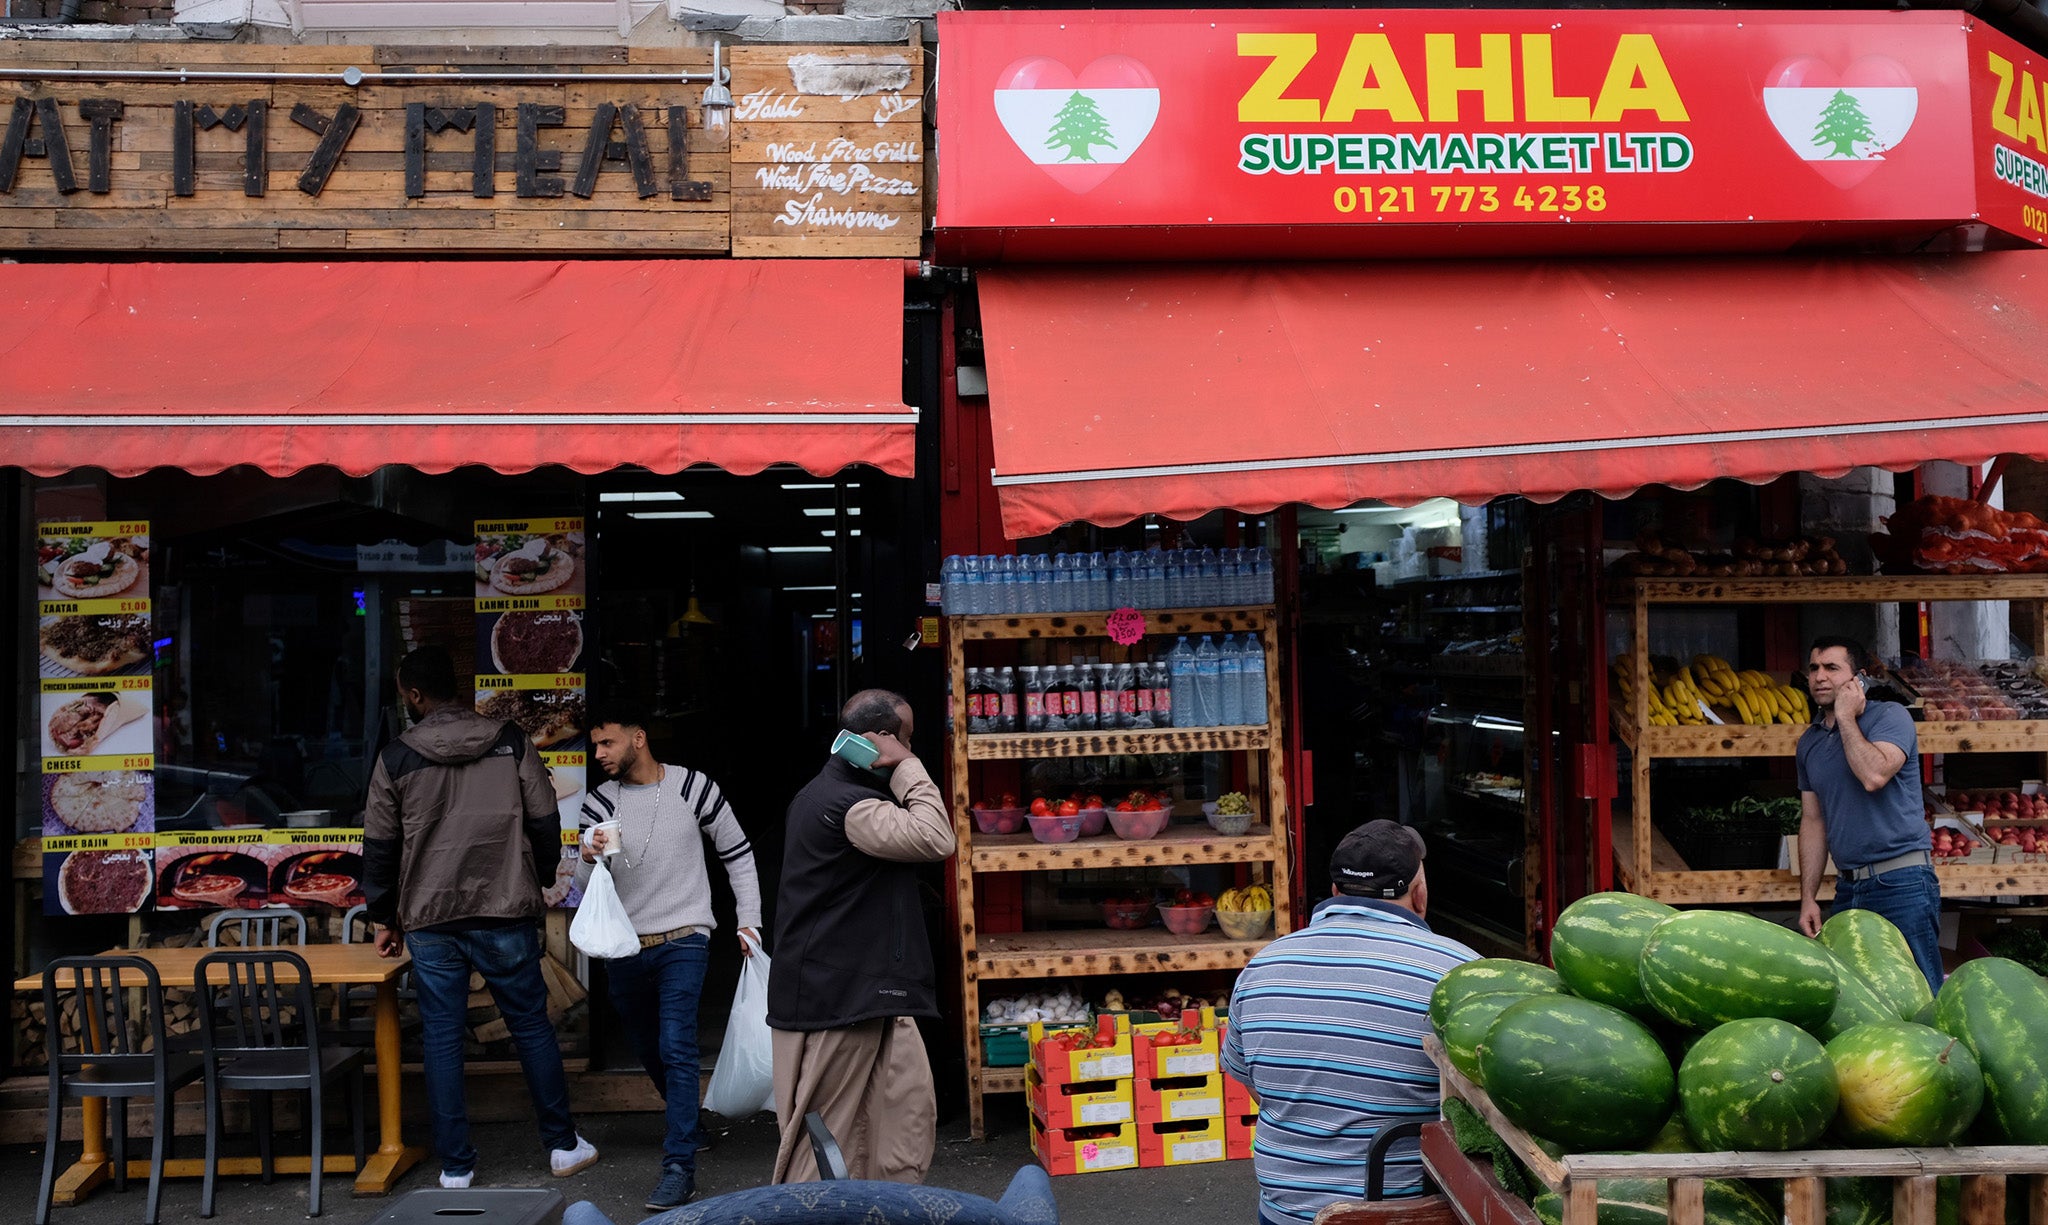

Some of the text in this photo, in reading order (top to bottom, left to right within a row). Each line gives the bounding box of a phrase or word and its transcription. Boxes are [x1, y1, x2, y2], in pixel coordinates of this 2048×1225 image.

[1236, 32, 1691, 123] ZAHLA
[1988, 50, 2048, 154] ZA
[0, 97, 712, 201] AT MY MEAL
[766, 138, 921, 163] Wood Fire Grill
[1239, 133, 1694, 175] SUPERMARKET LTD
[755, 162, 919, 195] Wood Fire Pizza
[1333, 185, 1607, 213] 0121 773 4238
[2023, 204, 2048, 235] 0121
[41, 524, 147, 535] FALAFEL WRAP £2.00
[477, 521, 582, 532] FALAFEL WRAP £2.00
[43, 602, 147, 613] ZAATAR £1.00
[479, 598, 582, 610] LAHME BAJIN £1.50
[43, 683, 66, 691] CHICKEN
[100, 681, 116, 689] WRAP
[122, 679, 150, 688] £2.50
[479, 677, 582, 687] ZAATAR £1.00
[46, 758, 150, 770] CHEESE £1.50
[556, 755, 583, 764] £2.50
[47, 837, 151, 849] LAHME BAJIN £1.50
[179, 834, 263, 844] WOOD OVEN PIZZA
[291, 835, 320, 843] WOOD
[322, 834, 346, 843] OVEN
[562, 832, 579, 842] 1.5
